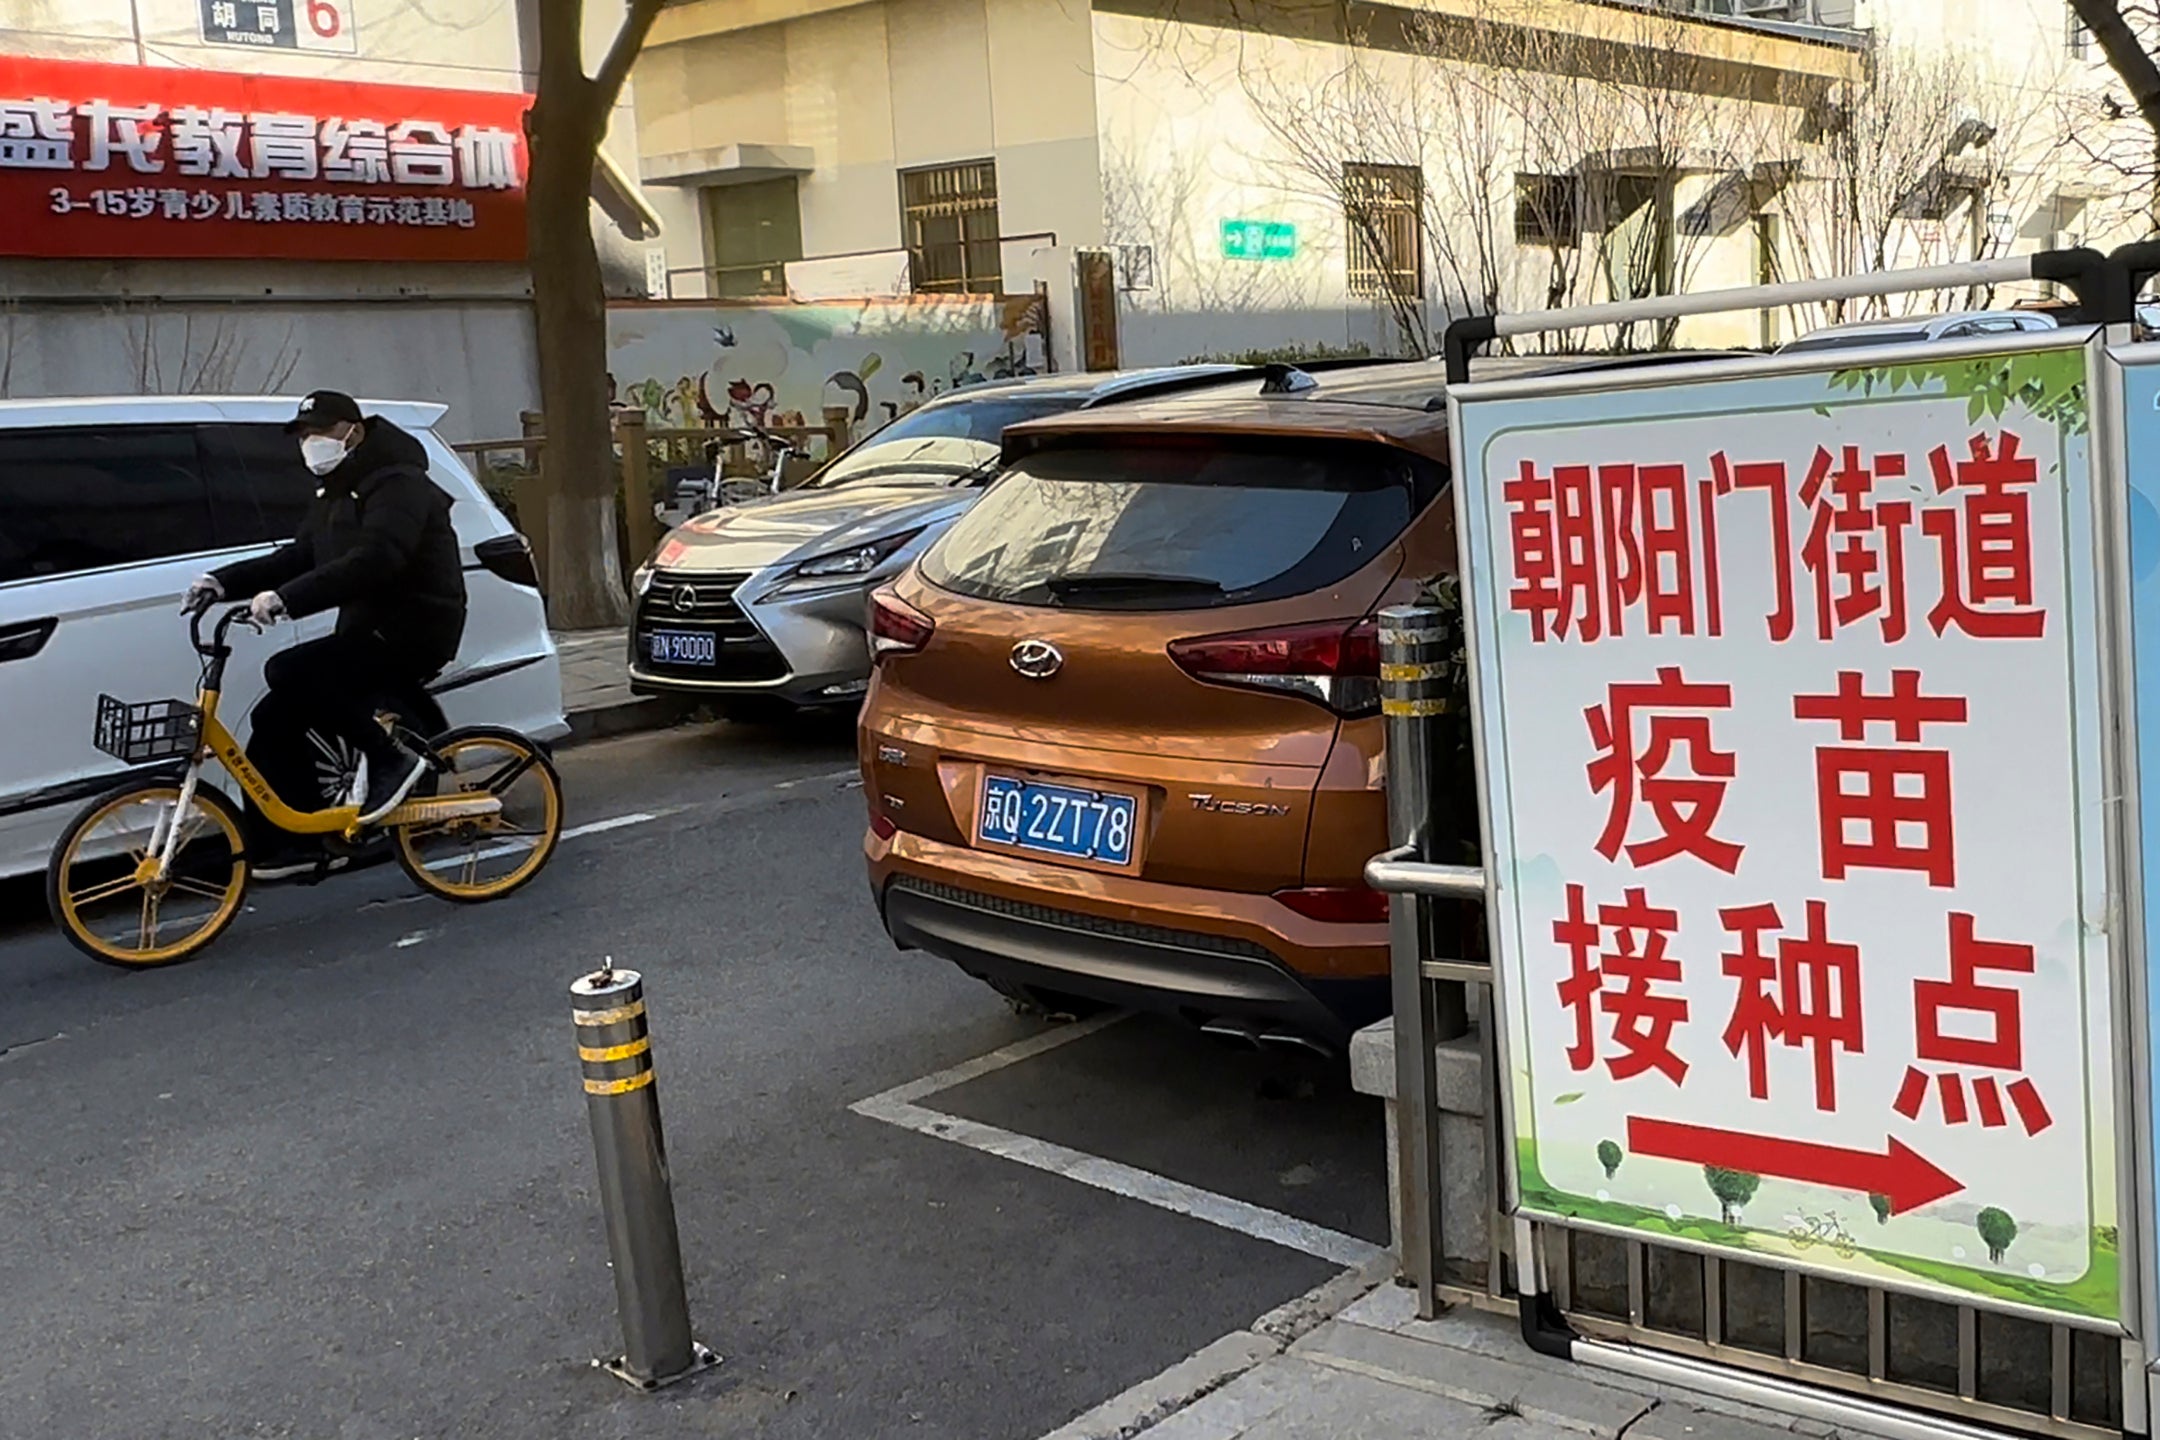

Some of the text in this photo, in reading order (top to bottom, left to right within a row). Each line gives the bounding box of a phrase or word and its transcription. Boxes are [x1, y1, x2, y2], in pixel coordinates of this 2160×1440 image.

[211, 1, 280, 34] 胡同
[307, 0, 340, 38] 6
[1503, 430, 2047, 645] 朝阳门街道
[1583, 666, 1968, 889] 疫苗
[1552, 882, 2054, 1138] 接种点
